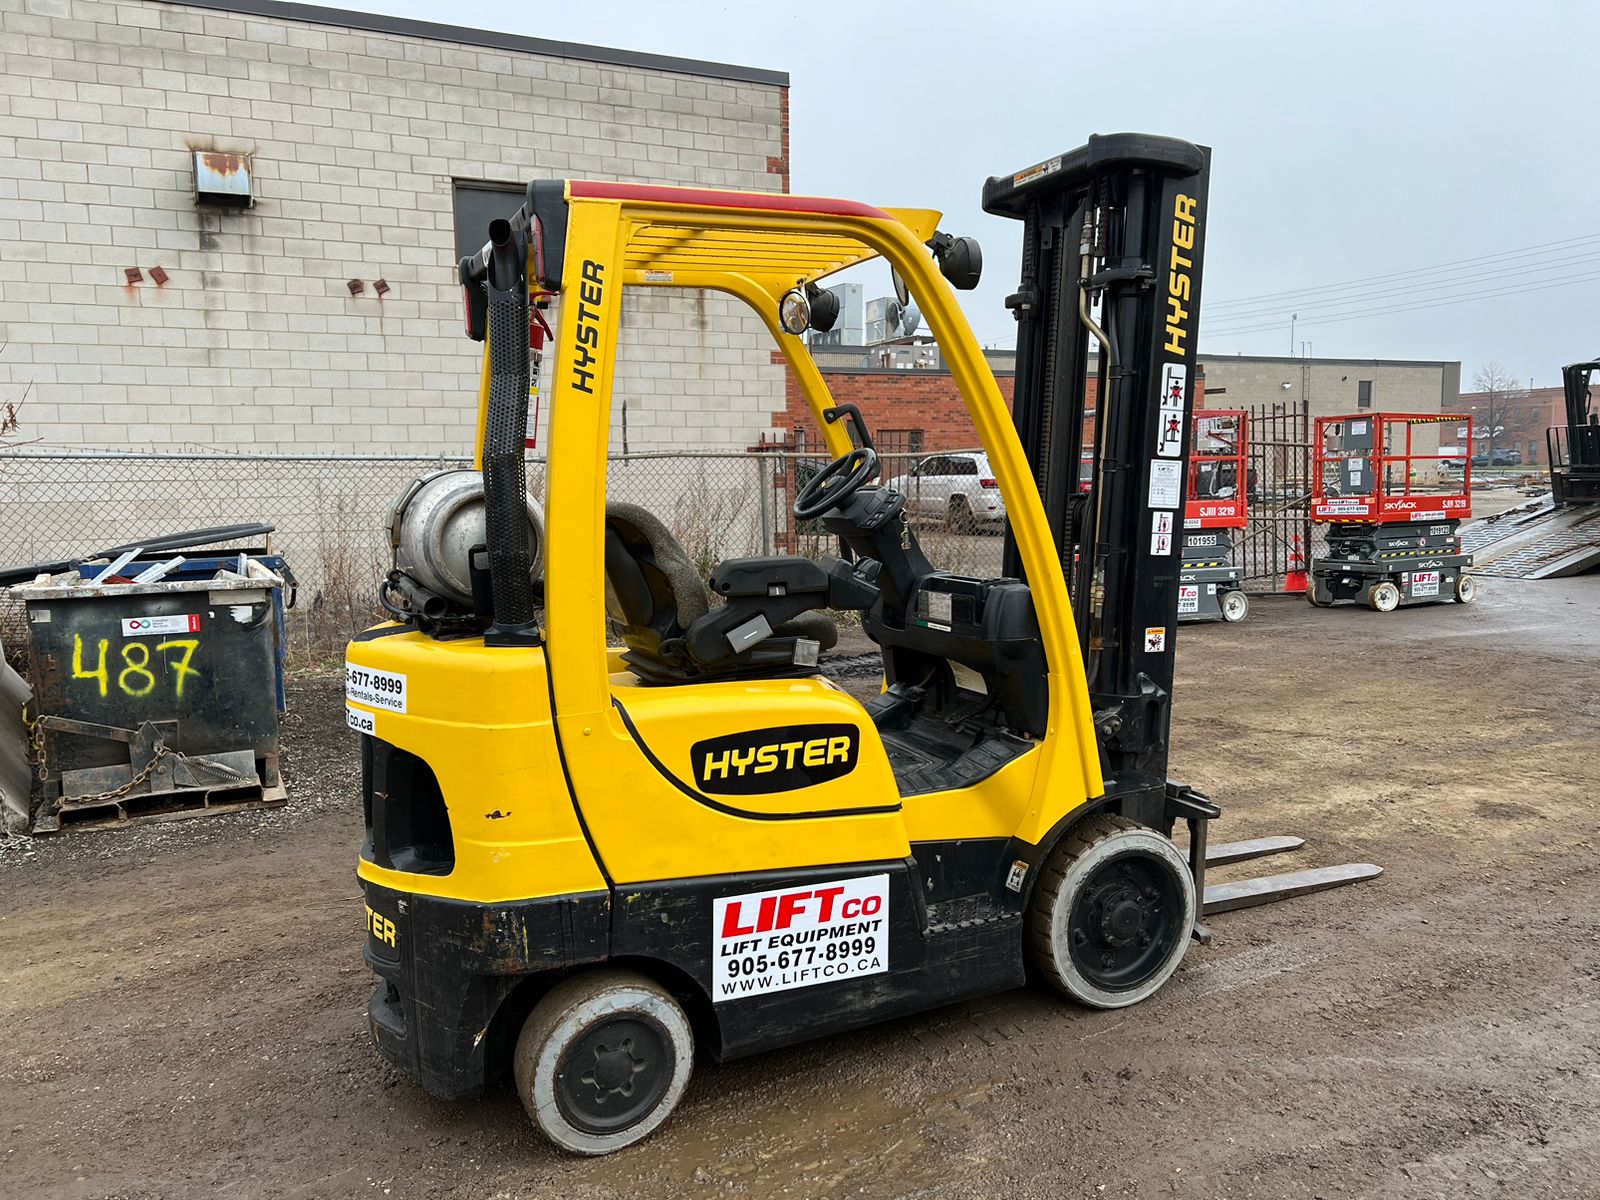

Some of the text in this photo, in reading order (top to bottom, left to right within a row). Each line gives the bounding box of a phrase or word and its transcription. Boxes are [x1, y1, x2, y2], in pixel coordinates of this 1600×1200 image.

[1164, 193, 1198, 357] HYSTER
[571, 259, 605, 395] HYSTER
[1217, 506, 1236, 516] 3219
[1384, 499, 1417, 510] SKYJACK
[1454, 499, 1467, 508] 3219
[1188, 536, 1216, 546] 101955
[1180, 588, 1197, 597] Tco
[71, 633, 200, 697] 487
[345, 668, 403, 695] 5-677-8999
[345, 687, 403, 709] s-Rentals-Service
[703, 736, 851, 781] HYSTER
[365, 904, 396, 948] TER
[720, 919, 882, 957] LIFT EQUIPMENT
[721, 957, 881, 995] WWW.LIFTCO.CA
[727, 936, 876, 978] 905-677-8999
